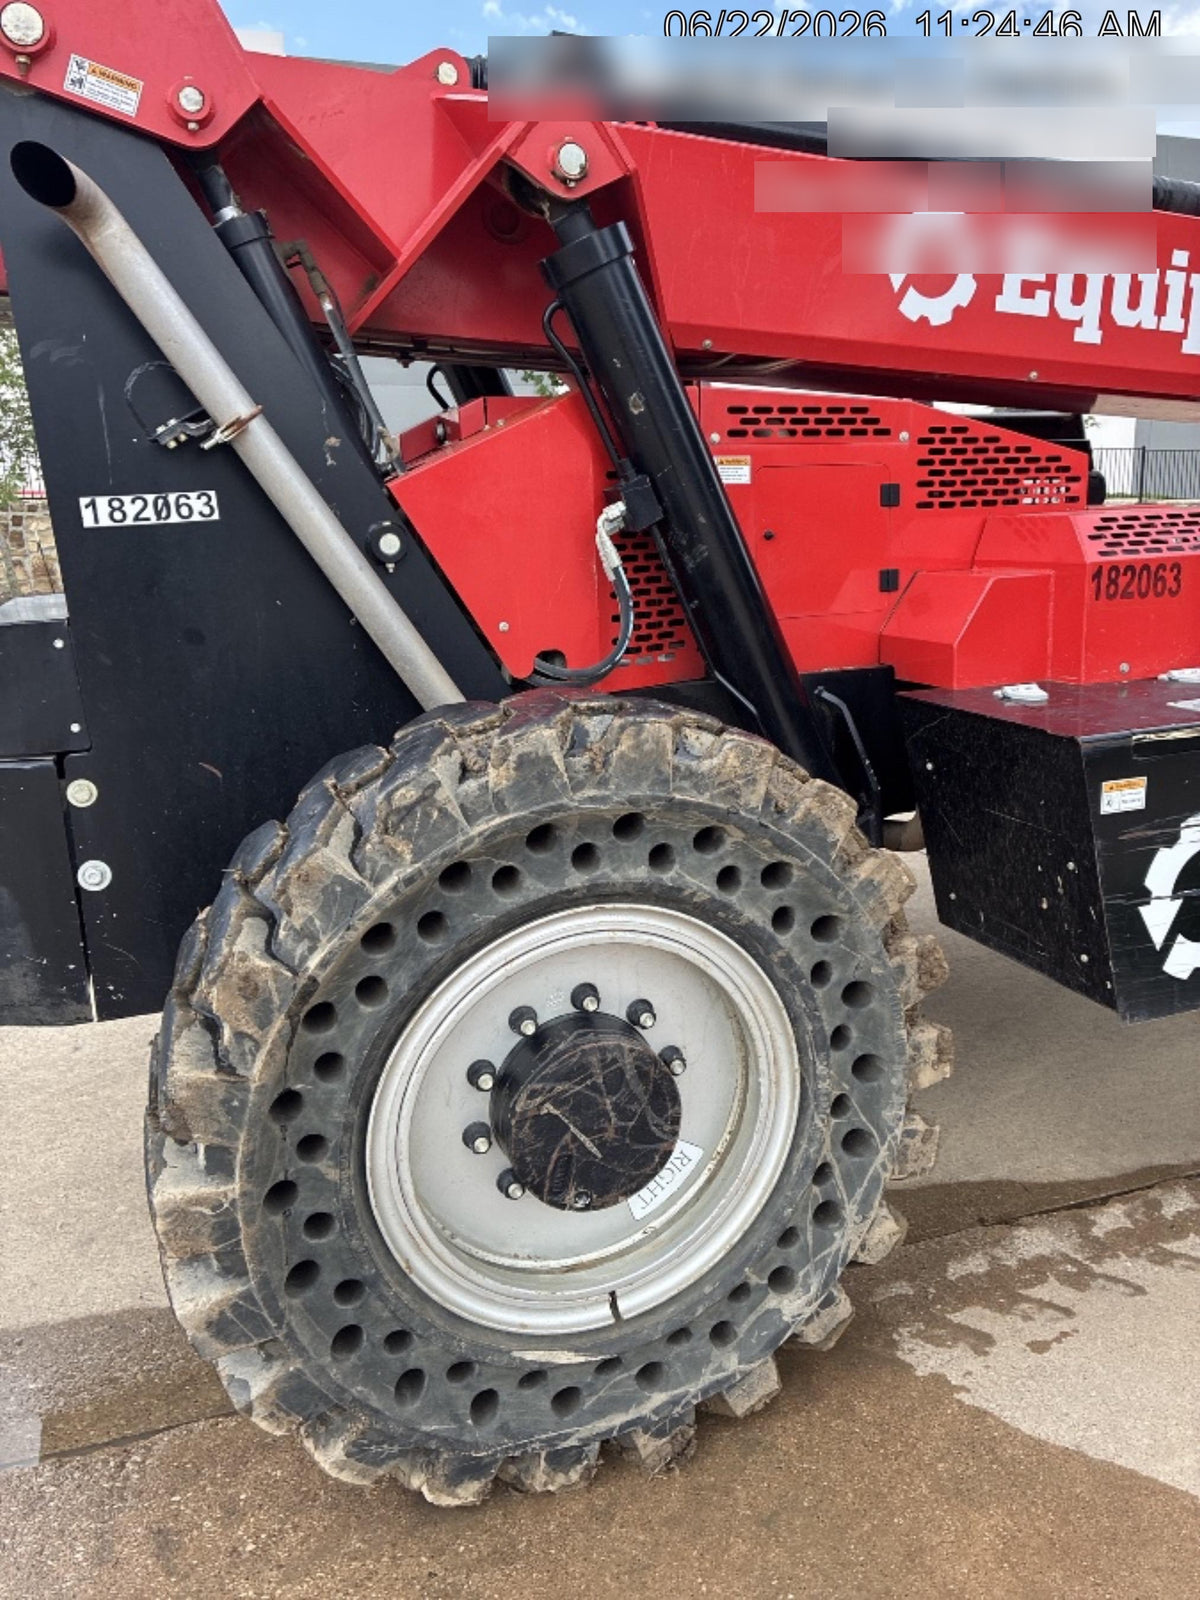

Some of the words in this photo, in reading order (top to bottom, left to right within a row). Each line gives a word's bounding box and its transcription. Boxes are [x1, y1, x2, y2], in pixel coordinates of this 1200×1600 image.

[84, 491, 217, 525] 182063
[1091, 561, 1182, 601] 182063
[637, 1150, 692, 1210] RIGHT
